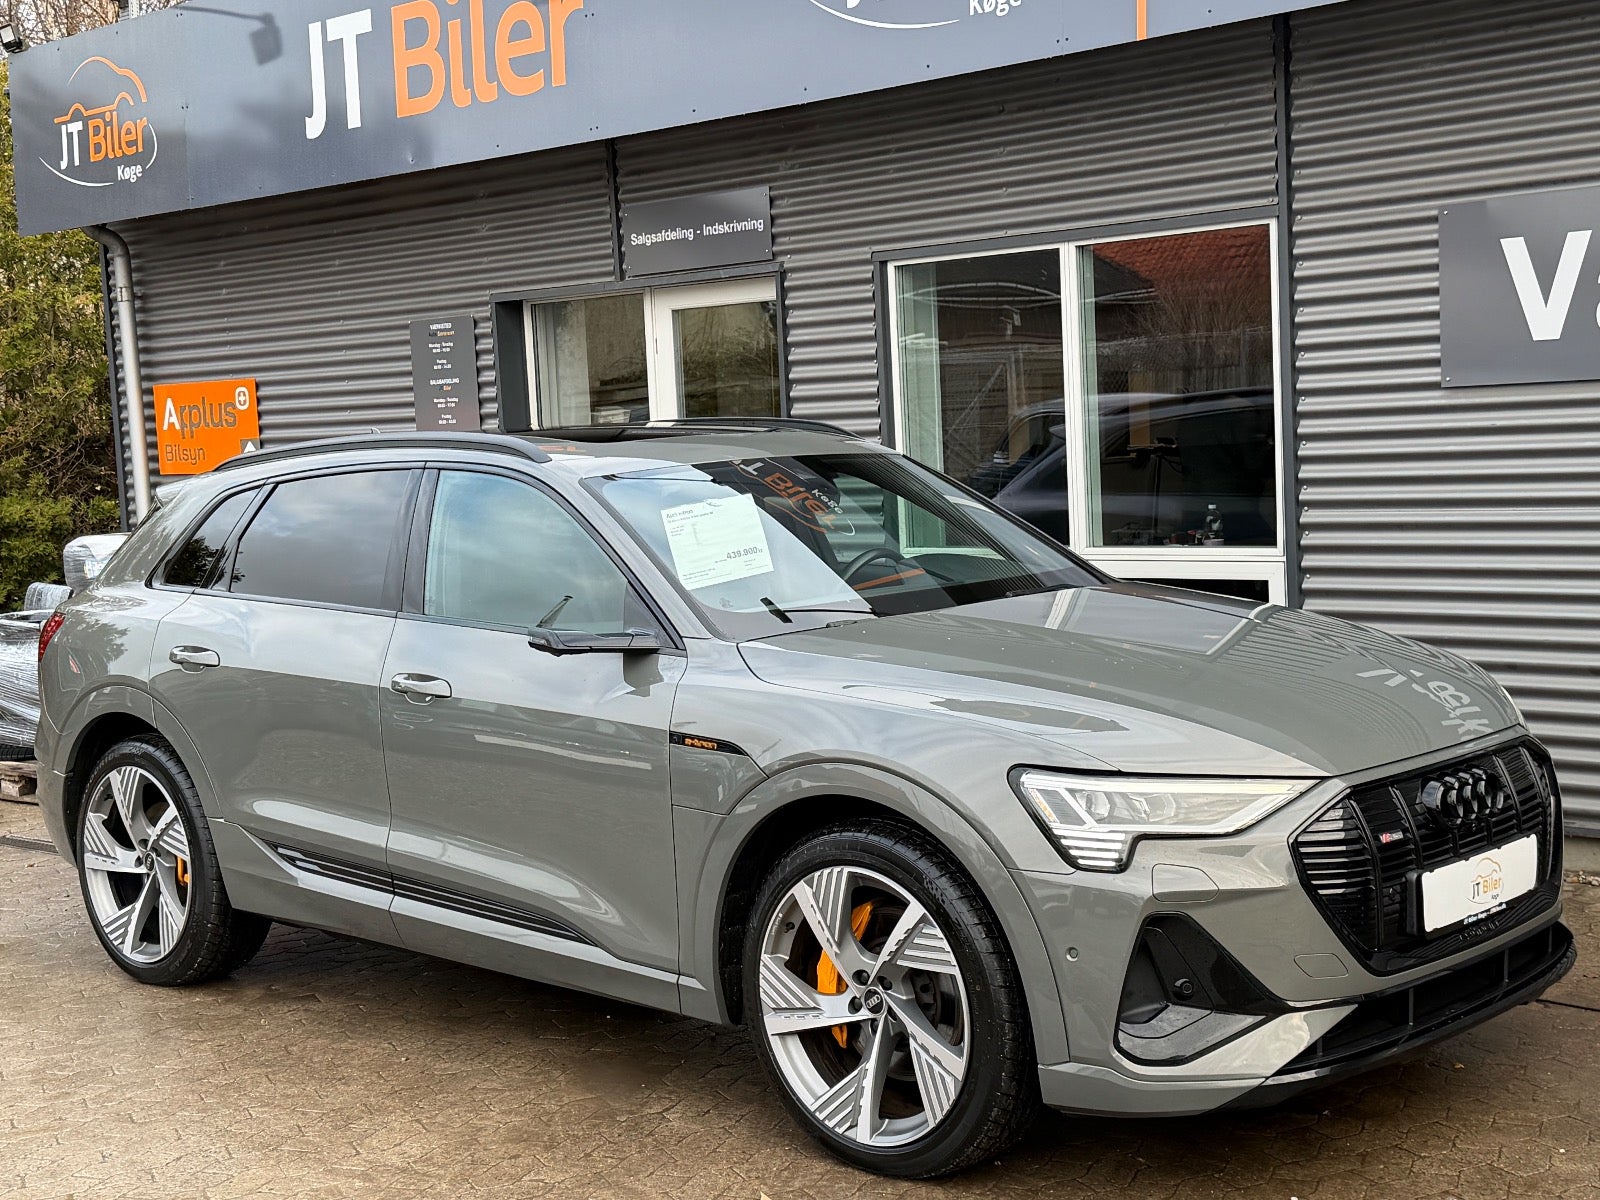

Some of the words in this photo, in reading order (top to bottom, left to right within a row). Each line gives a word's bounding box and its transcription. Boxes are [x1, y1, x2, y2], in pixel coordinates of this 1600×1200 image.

[305, 9, 373, 140] JT
[390, 0, 584, 119] Biler
[60, 120, 83, 170] JT
[87, 111, 147, 162] Biler
[117, 164, 143, 183] Køge
[630, 227, 694, 246] Salgsafdeling
[703, 218, 764, 237] Indskrivning
[1499, 229, 1600, 341] V
[165, 443, 206, 465] Bilsyn
[1482, 877, 1501, 894] Biler
